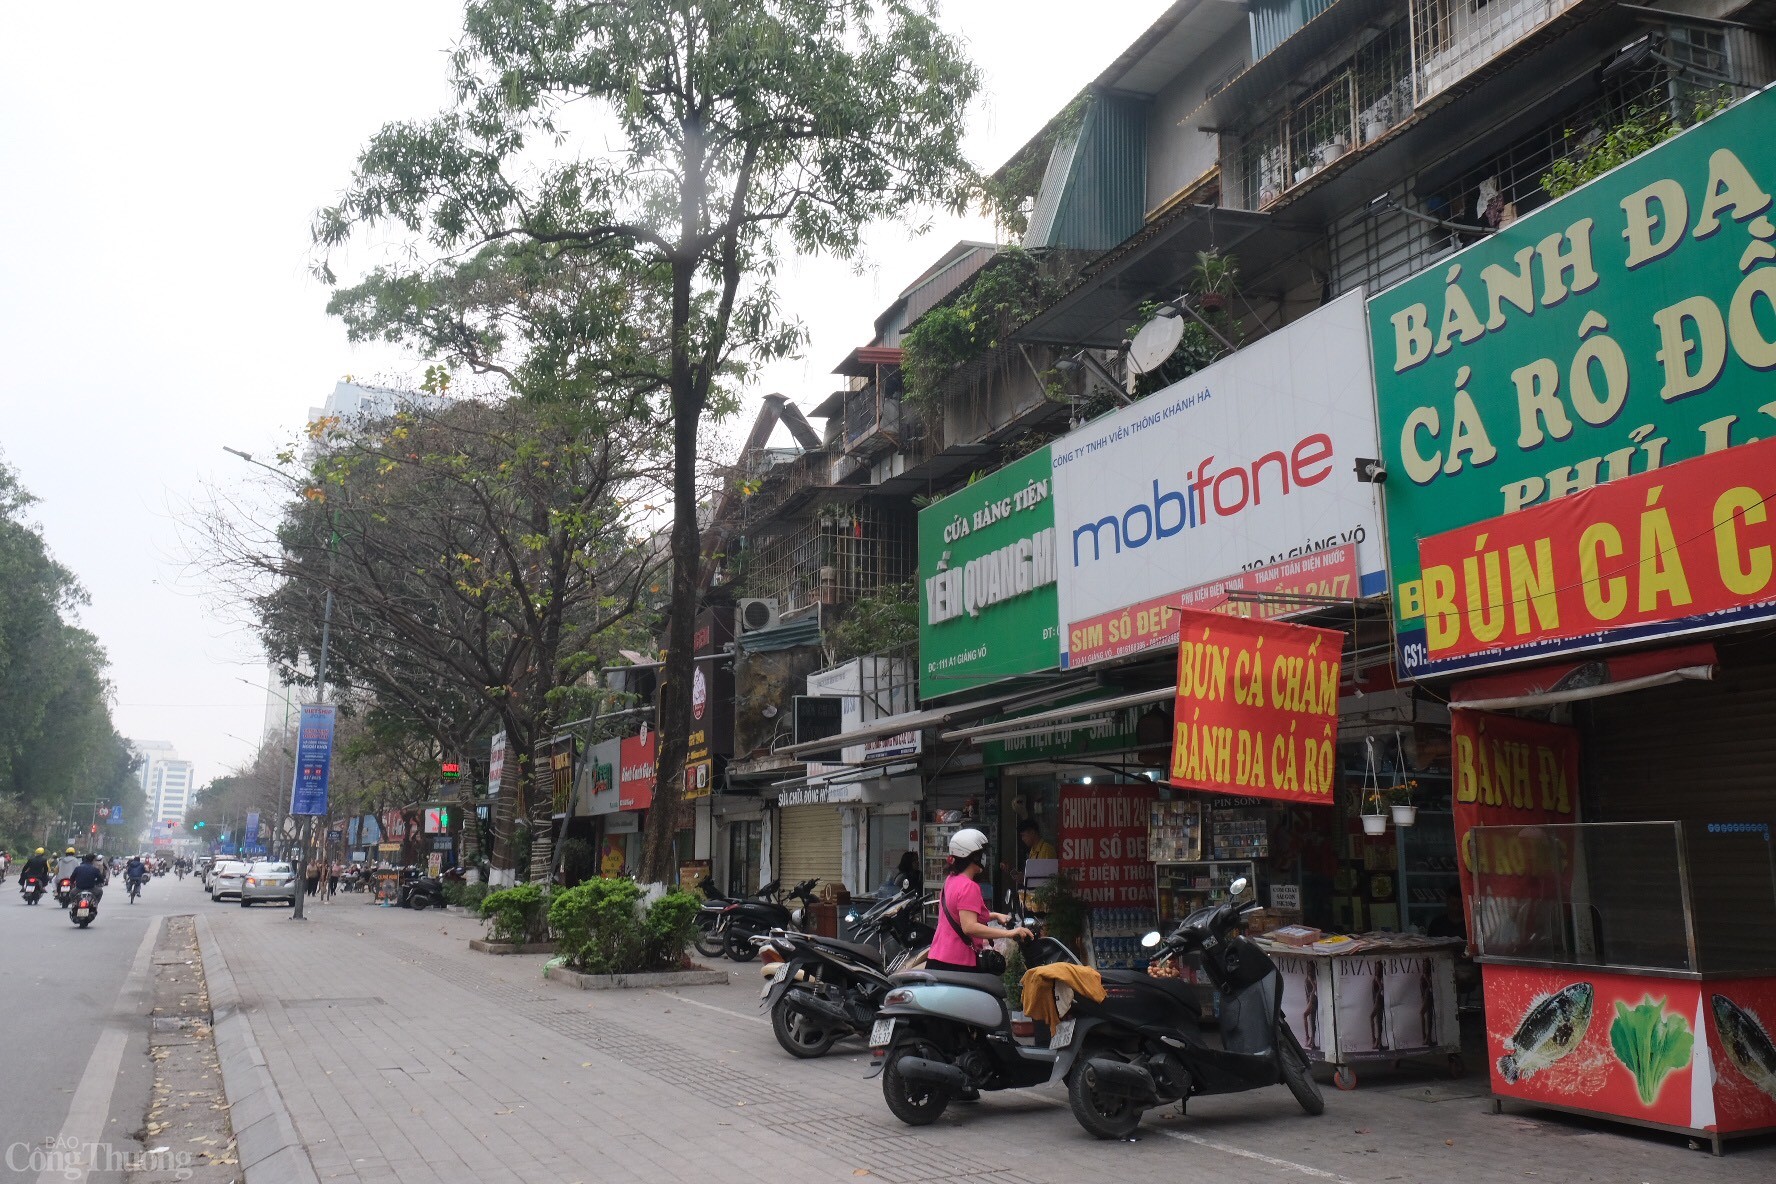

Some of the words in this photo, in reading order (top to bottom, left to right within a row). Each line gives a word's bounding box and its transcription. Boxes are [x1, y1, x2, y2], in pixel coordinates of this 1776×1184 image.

[1390, 218, 1598, 372] BÁNH
[1620, 148, 1771, 269] ĐA
[1400, 366, 1497, 483] CÁ
[1511, 310, 1628, 448] RÔ
[1053, 452, 1073, 468] CÔNG
[1075, 446, 1085, 459] TY
[1086, 436, 1107, 453] TNHH
[1131, 412, 1160, 433] THÔNG
[1163, 399, 1195, 420] KHÁNH
[1197, 386, 1211, 404] HÀ
[944, 515, 970, 543] CỬA
[973, 501, 1011, 531] HÀNG
[1014, 479, 1049, 513] TIỆN
[1073, 433, 1333, 567] mobifone
[1341, 525, 1366, 544] VÕ
[926, 551, 963, 625] YẾN
[964, 538, 1033, 618] QUANG
[1255, 569, 1279, 584] THANH
[1281, 561, 1300, 578] TOÁN
[1302, 555, 1321, 573] ĐIỆN
[1322, 549, 1345, 567] NƯỚC
[1422, 533, 1559, 651] BÚN
[1578, 485, 1692, 621] CÁ
[1713, 486, 1773, 595] C
[1181, 592, 1194, 605] PHỤ
[1195, 586, 1209, 602] KIỆN
[1071, 623, 1103, 653] SIM
[1108, 607, 1131, 643] SỐ
[1136, 605, 1173, 637] ĐẸP
[949, 651, 957, 666] A1
[957, 645, 977, 665] GIẢNG
[977, 643, 988, 657] VÕ
[1179, 627, 1229, 702] BÚN
[1233, 636, 1264, 707] CÁ
[1271, 634, 1338, 716] CHẤM
[1173, 707, 1232, 783] BÁNH
[1236, 730, 1265, 787] ĐA
[1272, 720, 1298, 791] CÁ
[1303, 723, 1333, 794] RÔ
[1456, 717, 1534, 810] BÁNH
[1062, 786, 1105, 829] CHUYỂN
[1107, 787, 1131, 829] TIỀN
[1214, 798, 1231, 807] PIN
[1233, 797, 1262, 806] SONY
[1062, 838, 1094, 861] SIM
[1100, 829, 1122, 859] SỐ
[1126, 837, 1148, 862] ĐẸ
[1089, 863, 1120, 884] ĐIỆN
[1123, 864, 1156, 884] THOẠ
[1278, 957, 1319, 975] BAZAR
[1341, 959, 1387, 976] BAZAR
[1390, 957, 1435, 974] BAZAR
